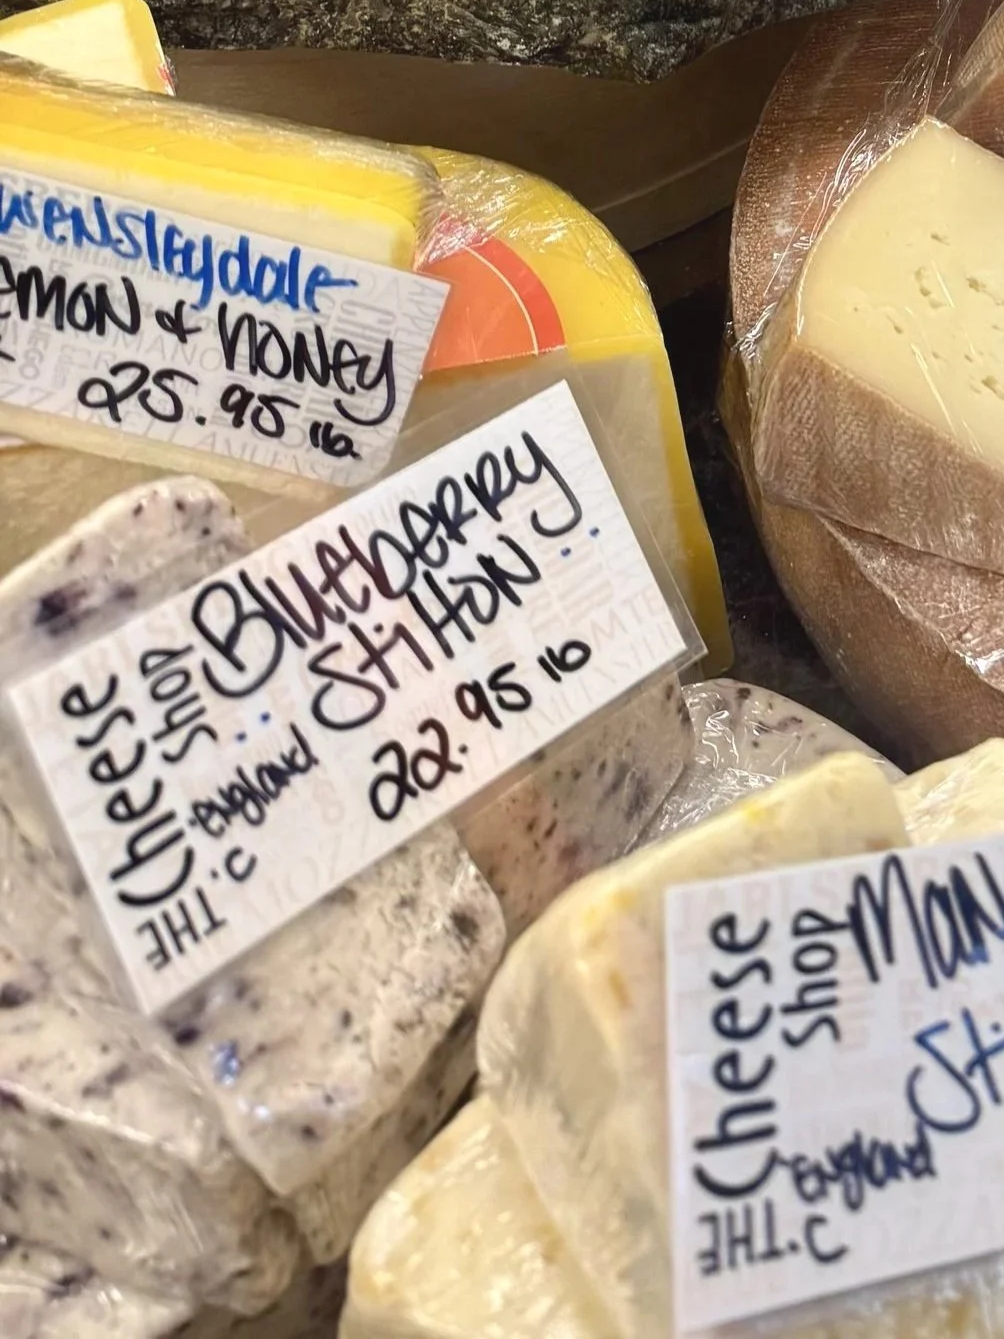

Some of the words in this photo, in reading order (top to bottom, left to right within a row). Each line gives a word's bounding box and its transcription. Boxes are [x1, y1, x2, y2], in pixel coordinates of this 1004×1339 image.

[77, 359, 301, 439] 25.95
[58, 672, 194, 908] Cheese
[368, 661, 533, 823] 22.95
[137, 886, 227, 972] THE
[693, 911, 785, 1200] Cheese
[698, 1199, 784, 1277] THE
